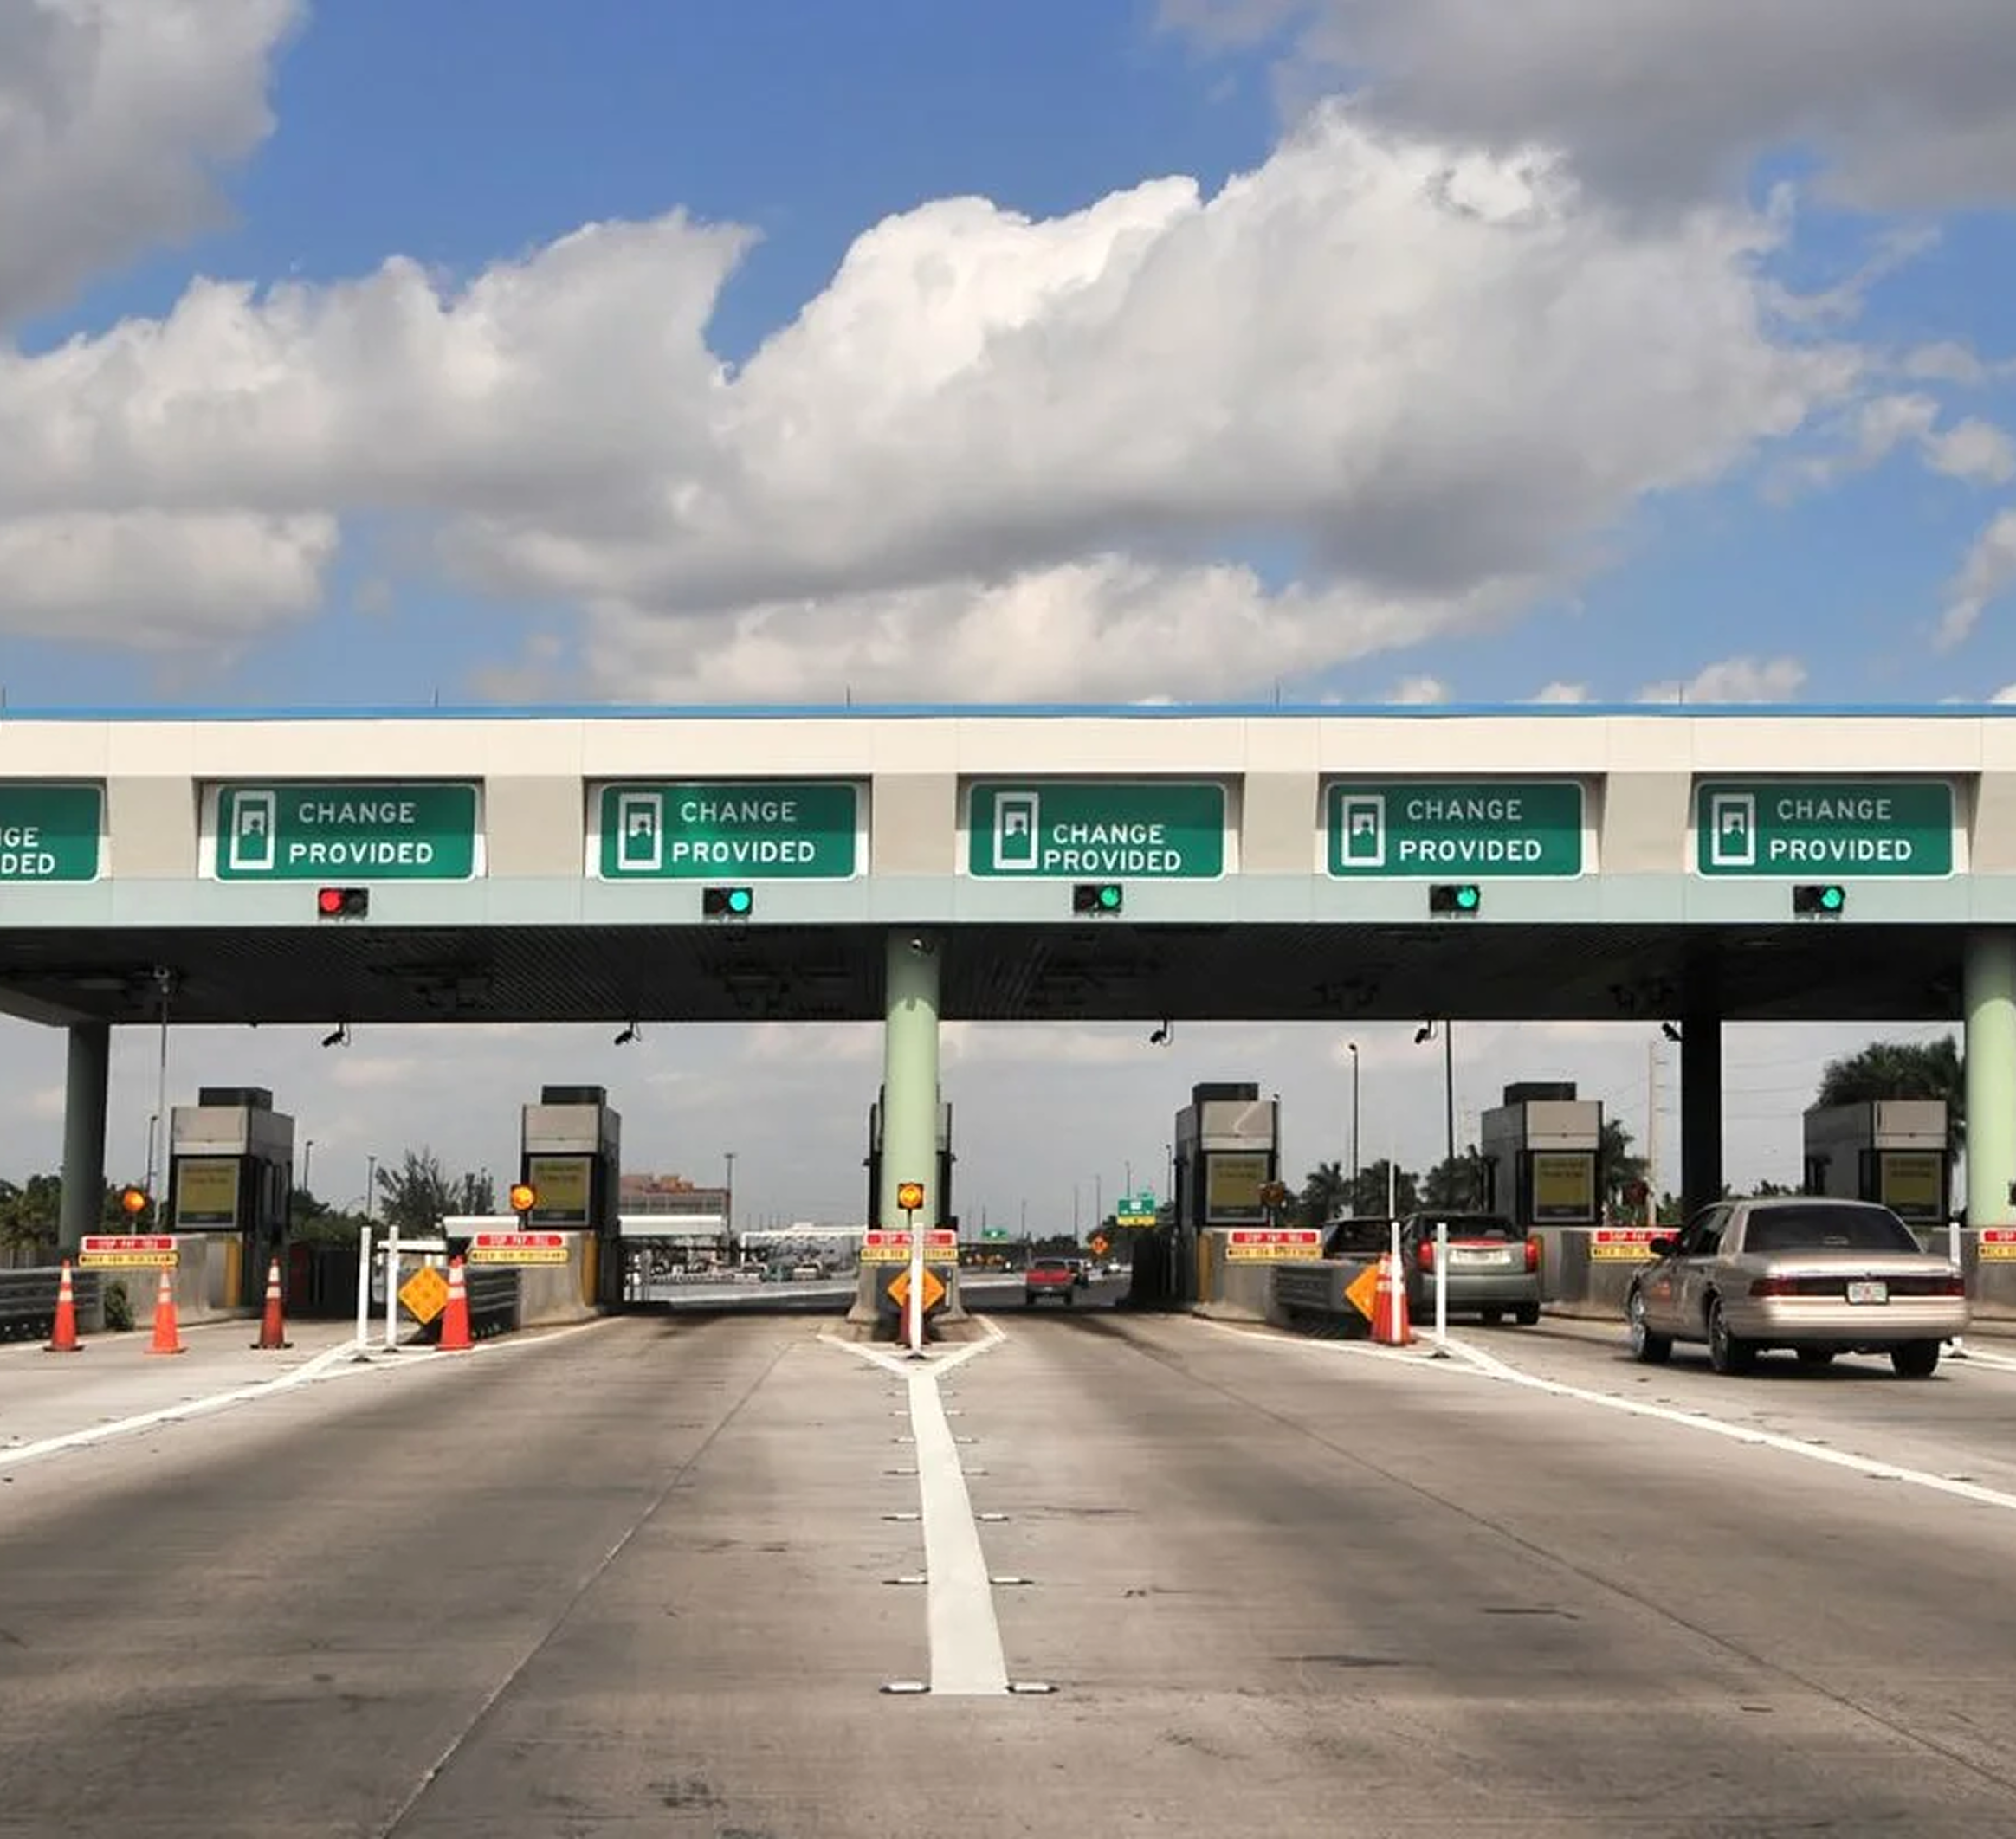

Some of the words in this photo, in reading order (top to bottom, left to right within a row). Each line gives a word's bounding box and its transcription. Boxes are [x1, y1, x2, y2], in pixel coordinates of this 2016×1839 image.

[300, 803, 415, 823] CHANGE
[681, 802, 796, 822] CHANGE
[1407, 800, 1522, 820] CHANGE
[1778, 800, 1891, 820] CHANGE
[0, 827, 39, 848] GE
[1052, 824, 1165, 845] CHANGE
[289, 842, 434, 864] PROVIDED
[672, 841, 816, 862] PROVIDED
[1044, 850, 1182, 871] PROVIDED
[1399, 839, 1542, 861] PROVIDED
[1769, 839, 1913, 861] PROVIDED
